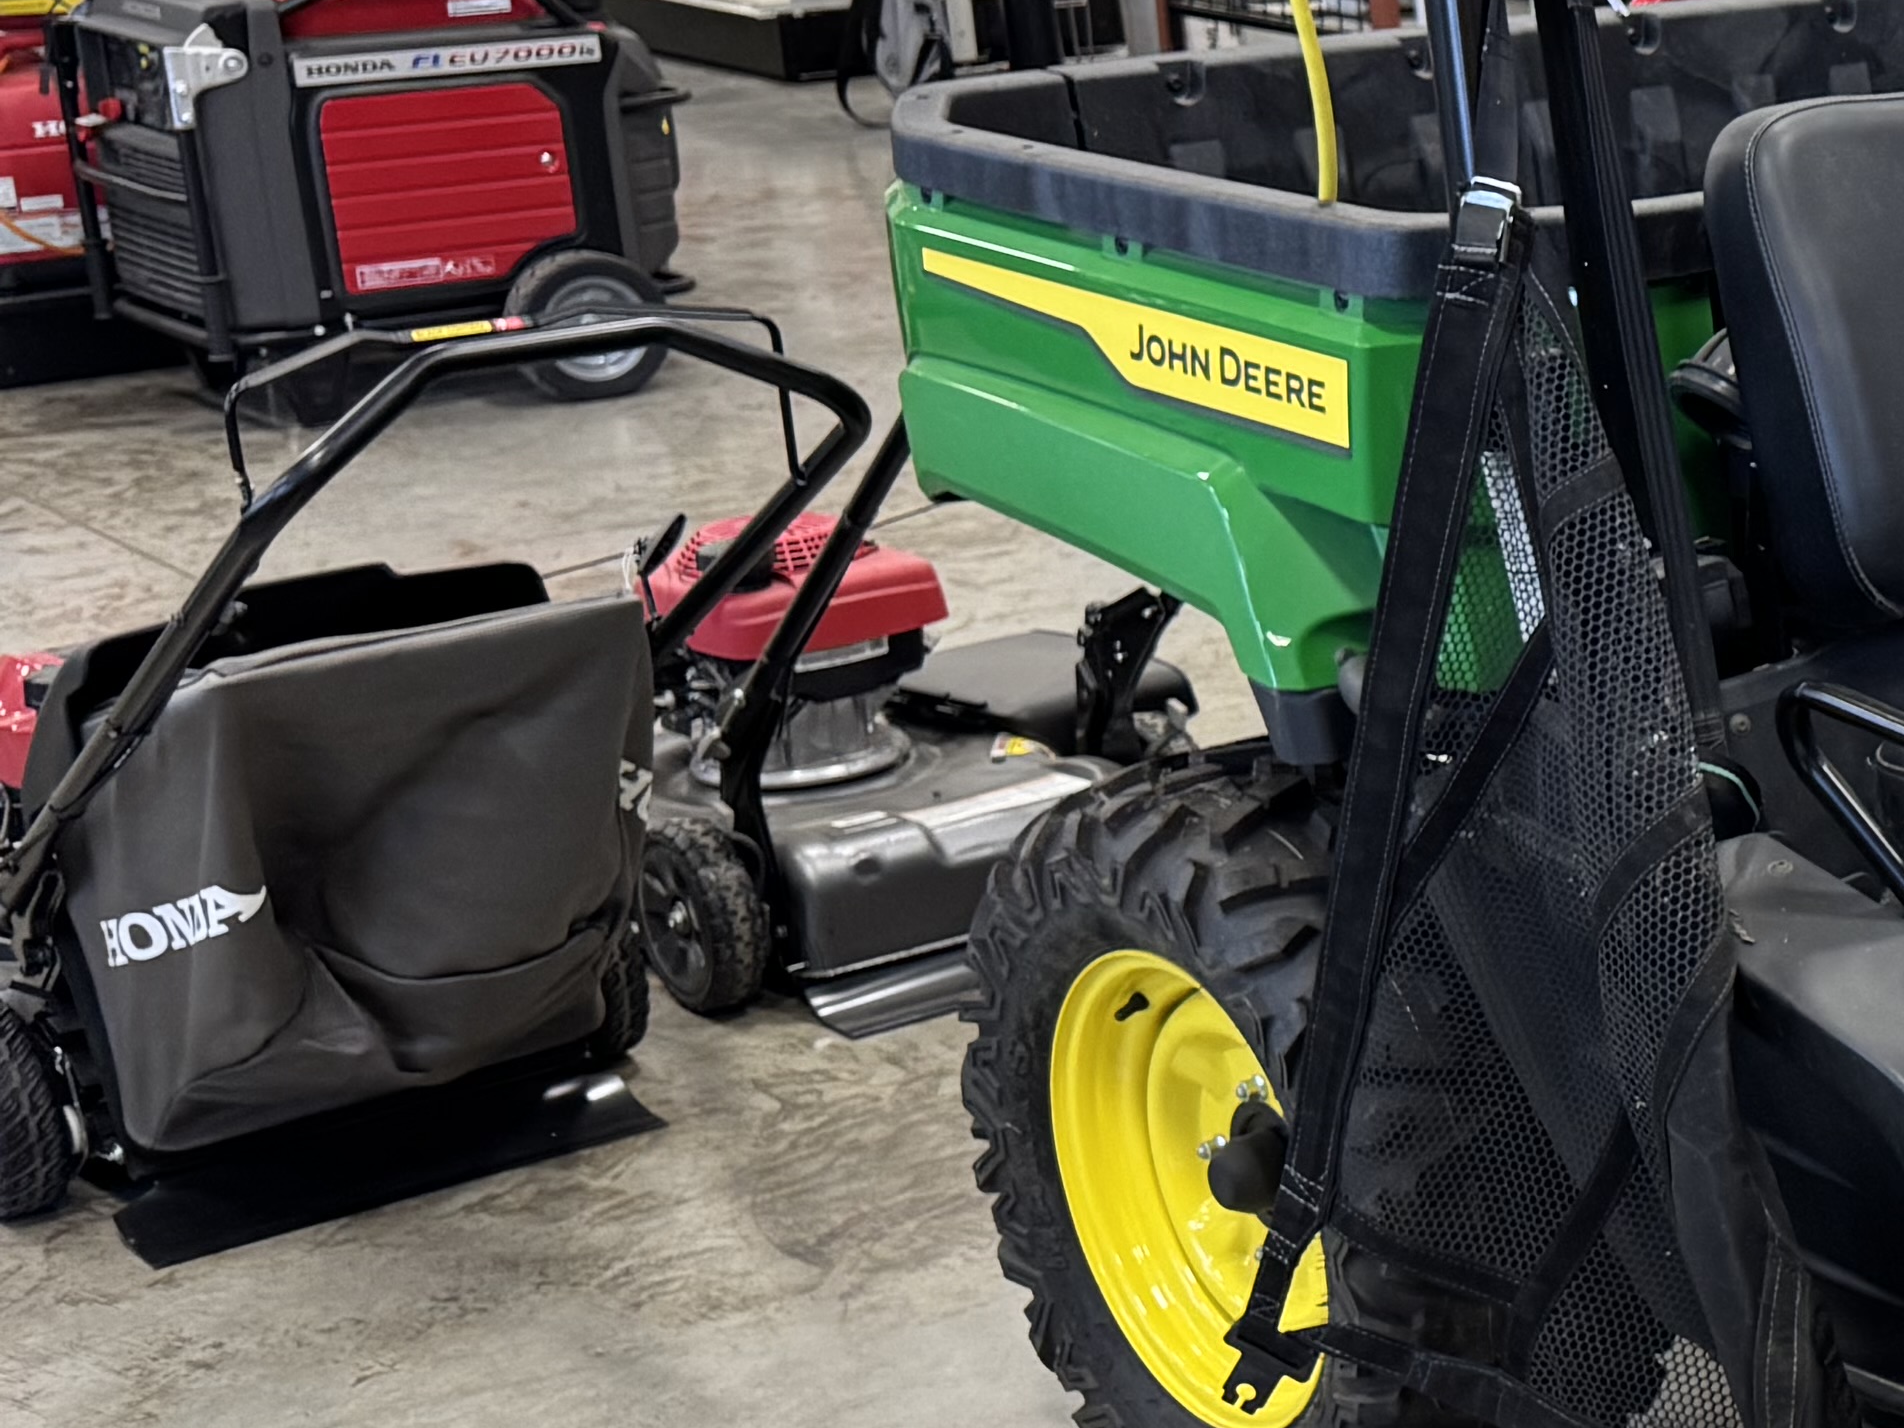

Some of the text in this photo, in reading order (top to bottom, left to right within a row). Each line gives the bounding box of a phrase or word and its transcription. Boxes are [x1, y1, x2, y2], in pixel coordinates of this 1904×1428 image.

[305, 57, 396, 79] HONDA
[1129, 324, 1327, 413] JOHN DEERE
[100, 884, 267, 968] HONDA
